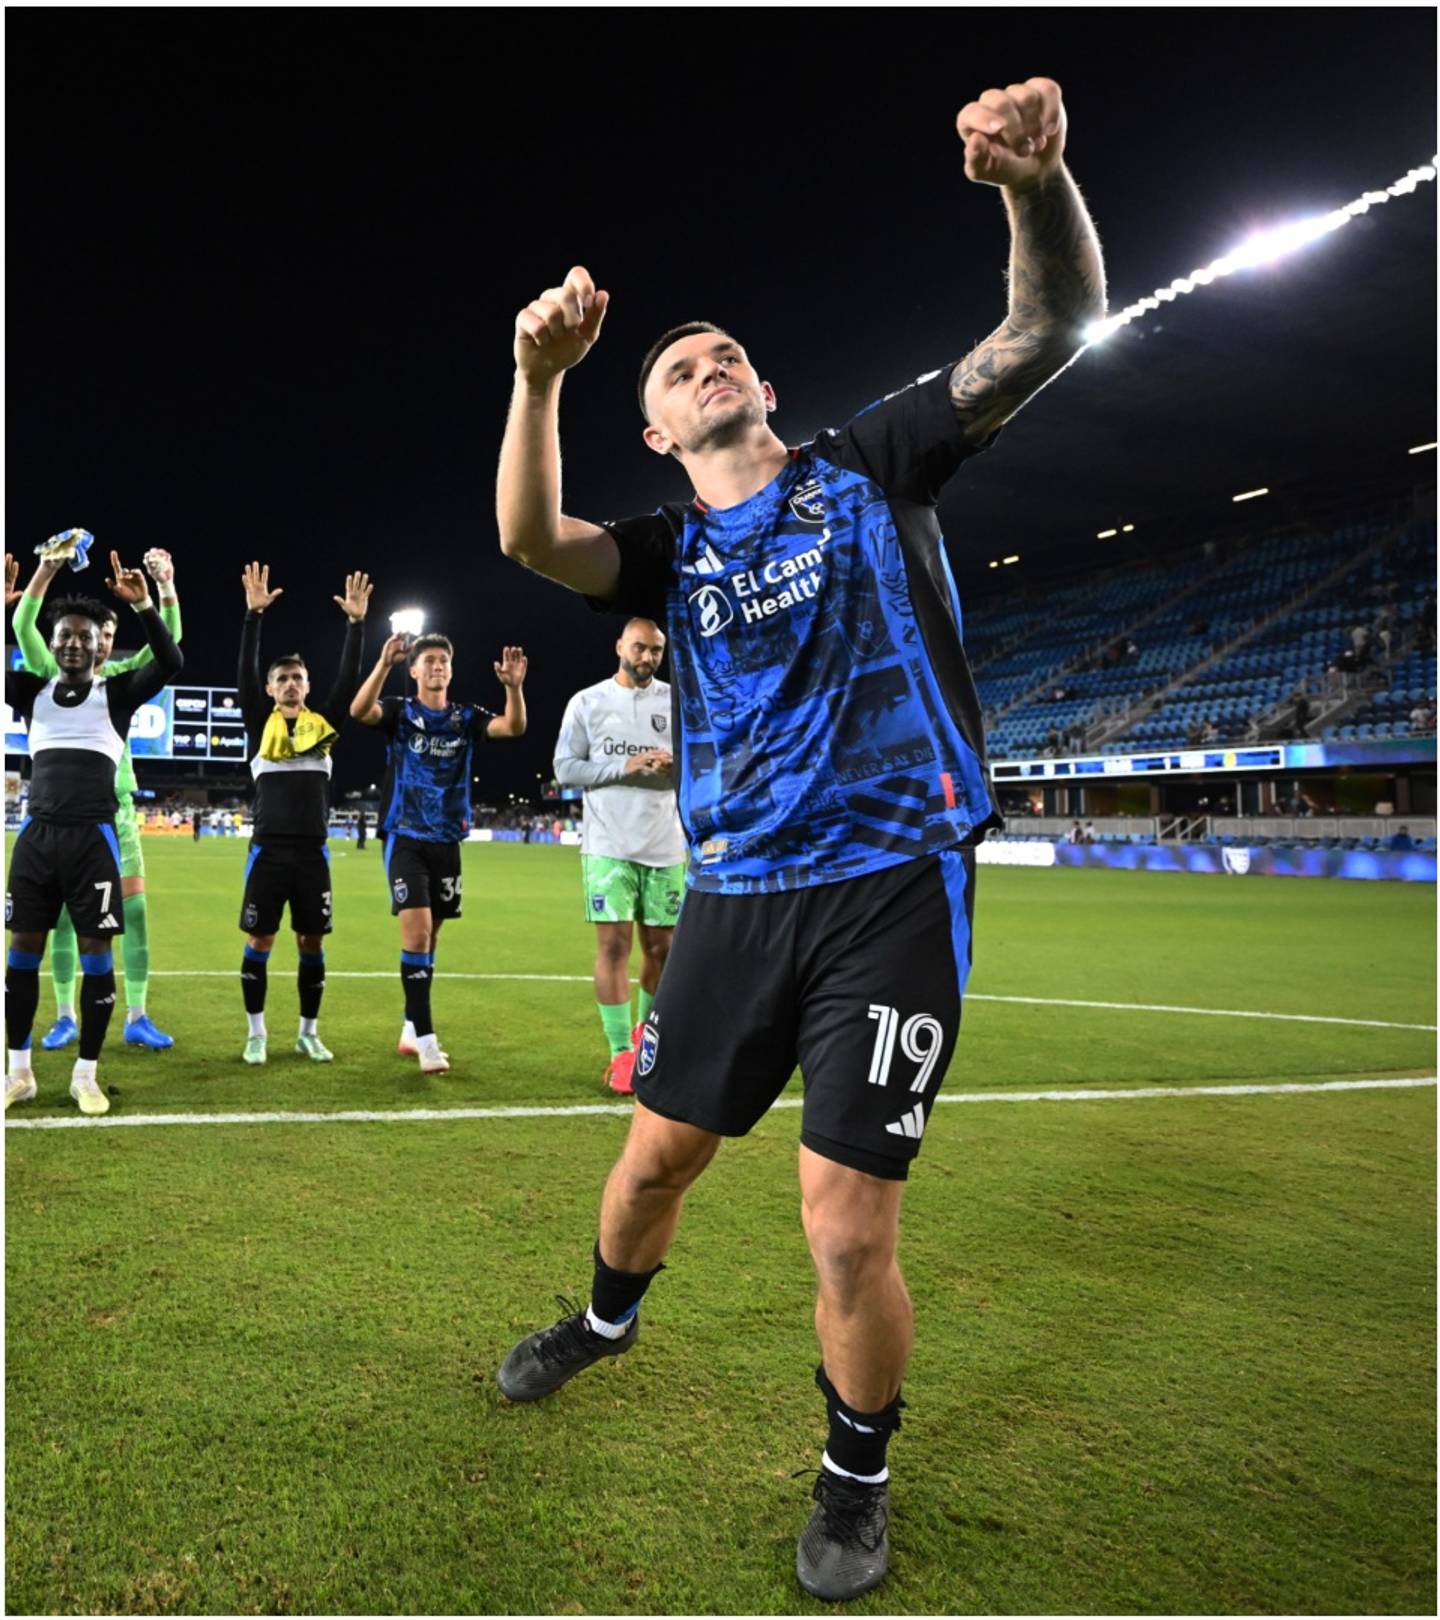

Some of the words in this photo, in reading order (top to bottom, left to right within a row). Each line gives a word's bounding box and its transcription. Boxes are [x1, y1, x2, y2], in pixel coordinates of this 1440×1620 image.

[731, 570, 761, 598] El
[764, 528, 832, 584] Cam
[94, 880, 112, 914] 7
[867, 1003, 944, 1094] 19
